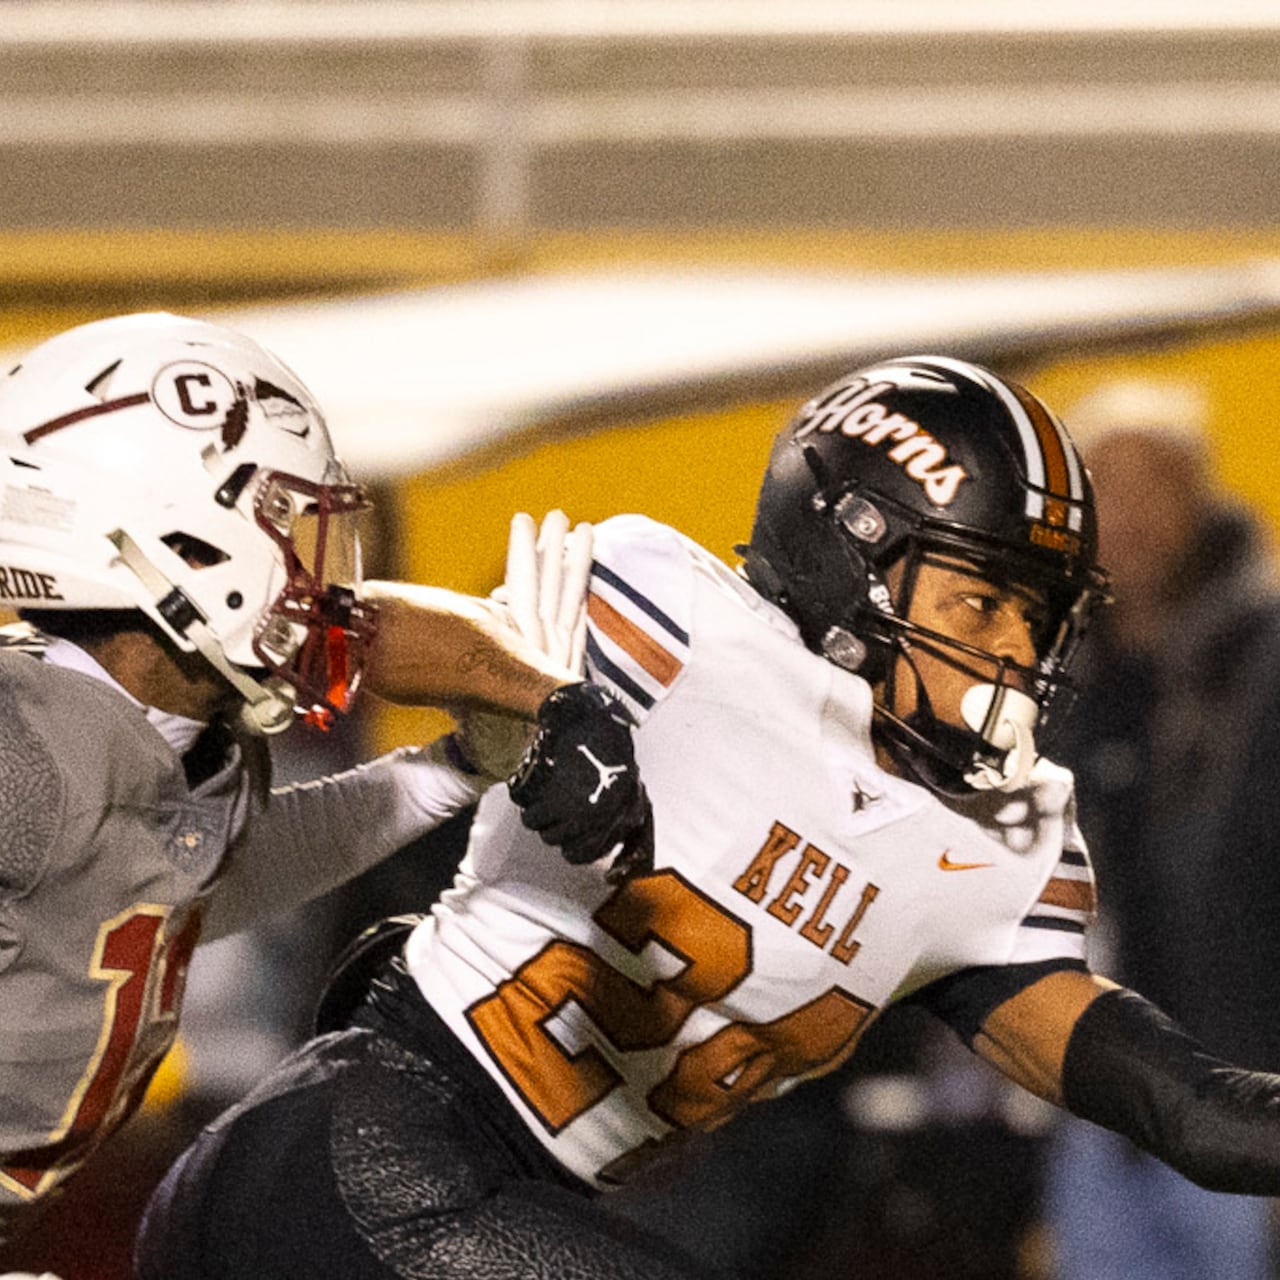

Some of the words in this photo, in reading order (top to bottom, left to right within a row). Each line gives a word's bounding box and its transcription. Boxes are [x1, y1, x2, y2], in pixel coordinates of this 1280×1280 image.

[173, 373, 218, 417] C
[794, 378, 968, 506] Horns
[731, 819, 881, 967] KELL
[462, 866, 878, 1186] 24
